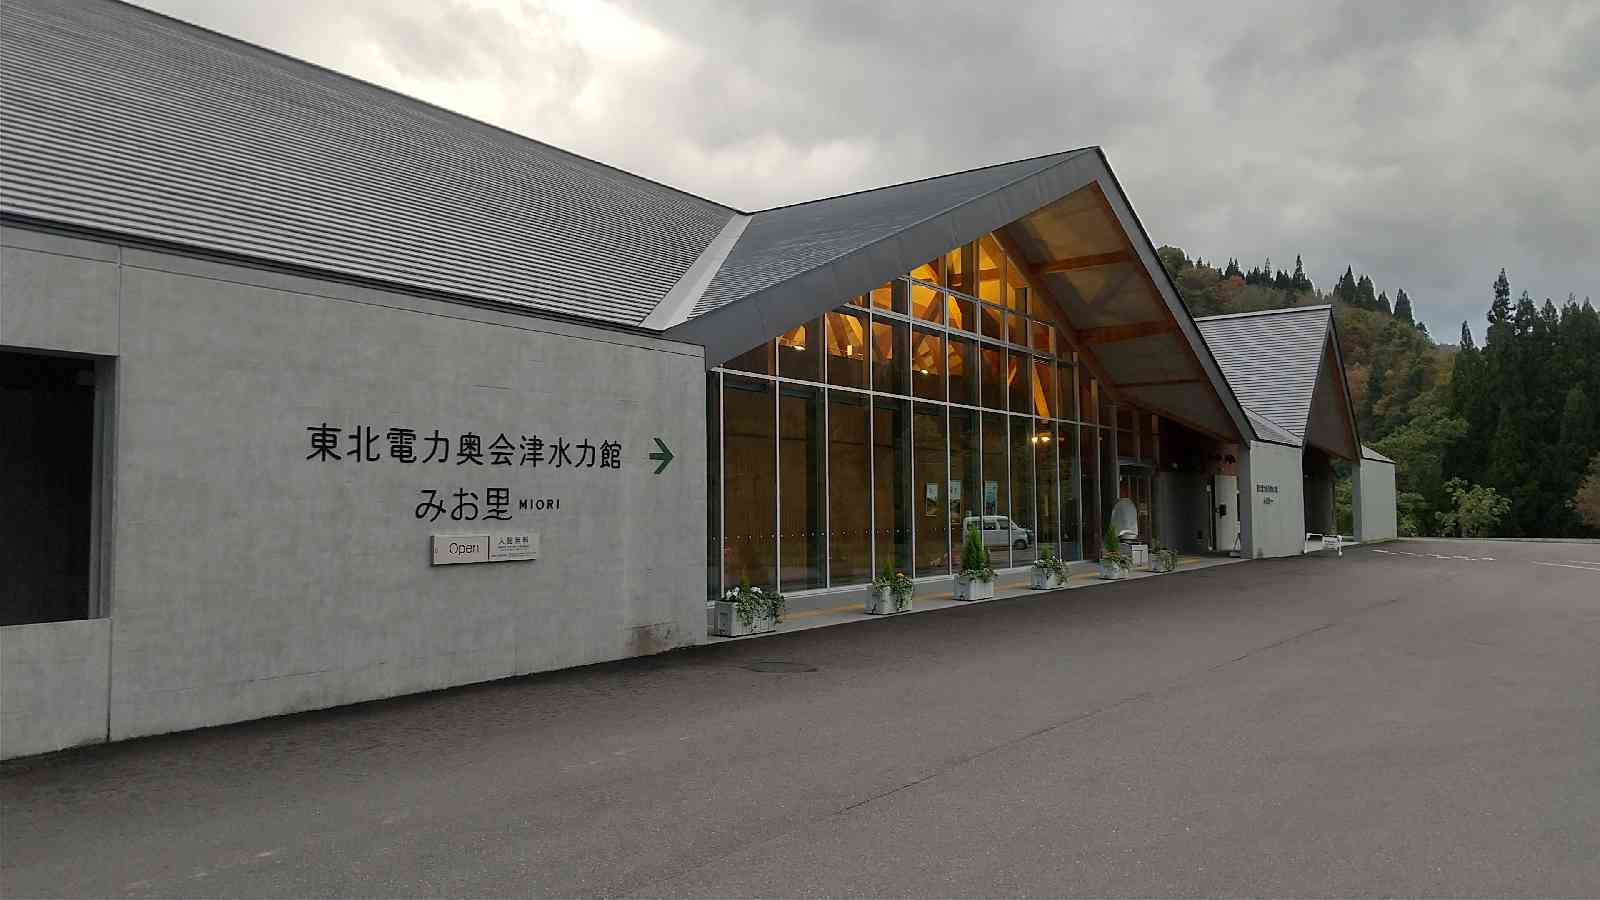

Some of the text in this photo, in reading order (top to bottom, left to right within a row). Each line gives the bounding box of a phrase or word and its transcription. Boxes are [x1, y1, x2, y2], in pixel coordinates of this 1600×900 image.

[306, 422, 622, 470] 東北電力奥会津水力館
[415, 487, 561, 523] みお里 MIORI
[448, 541, 480, 557] Open
